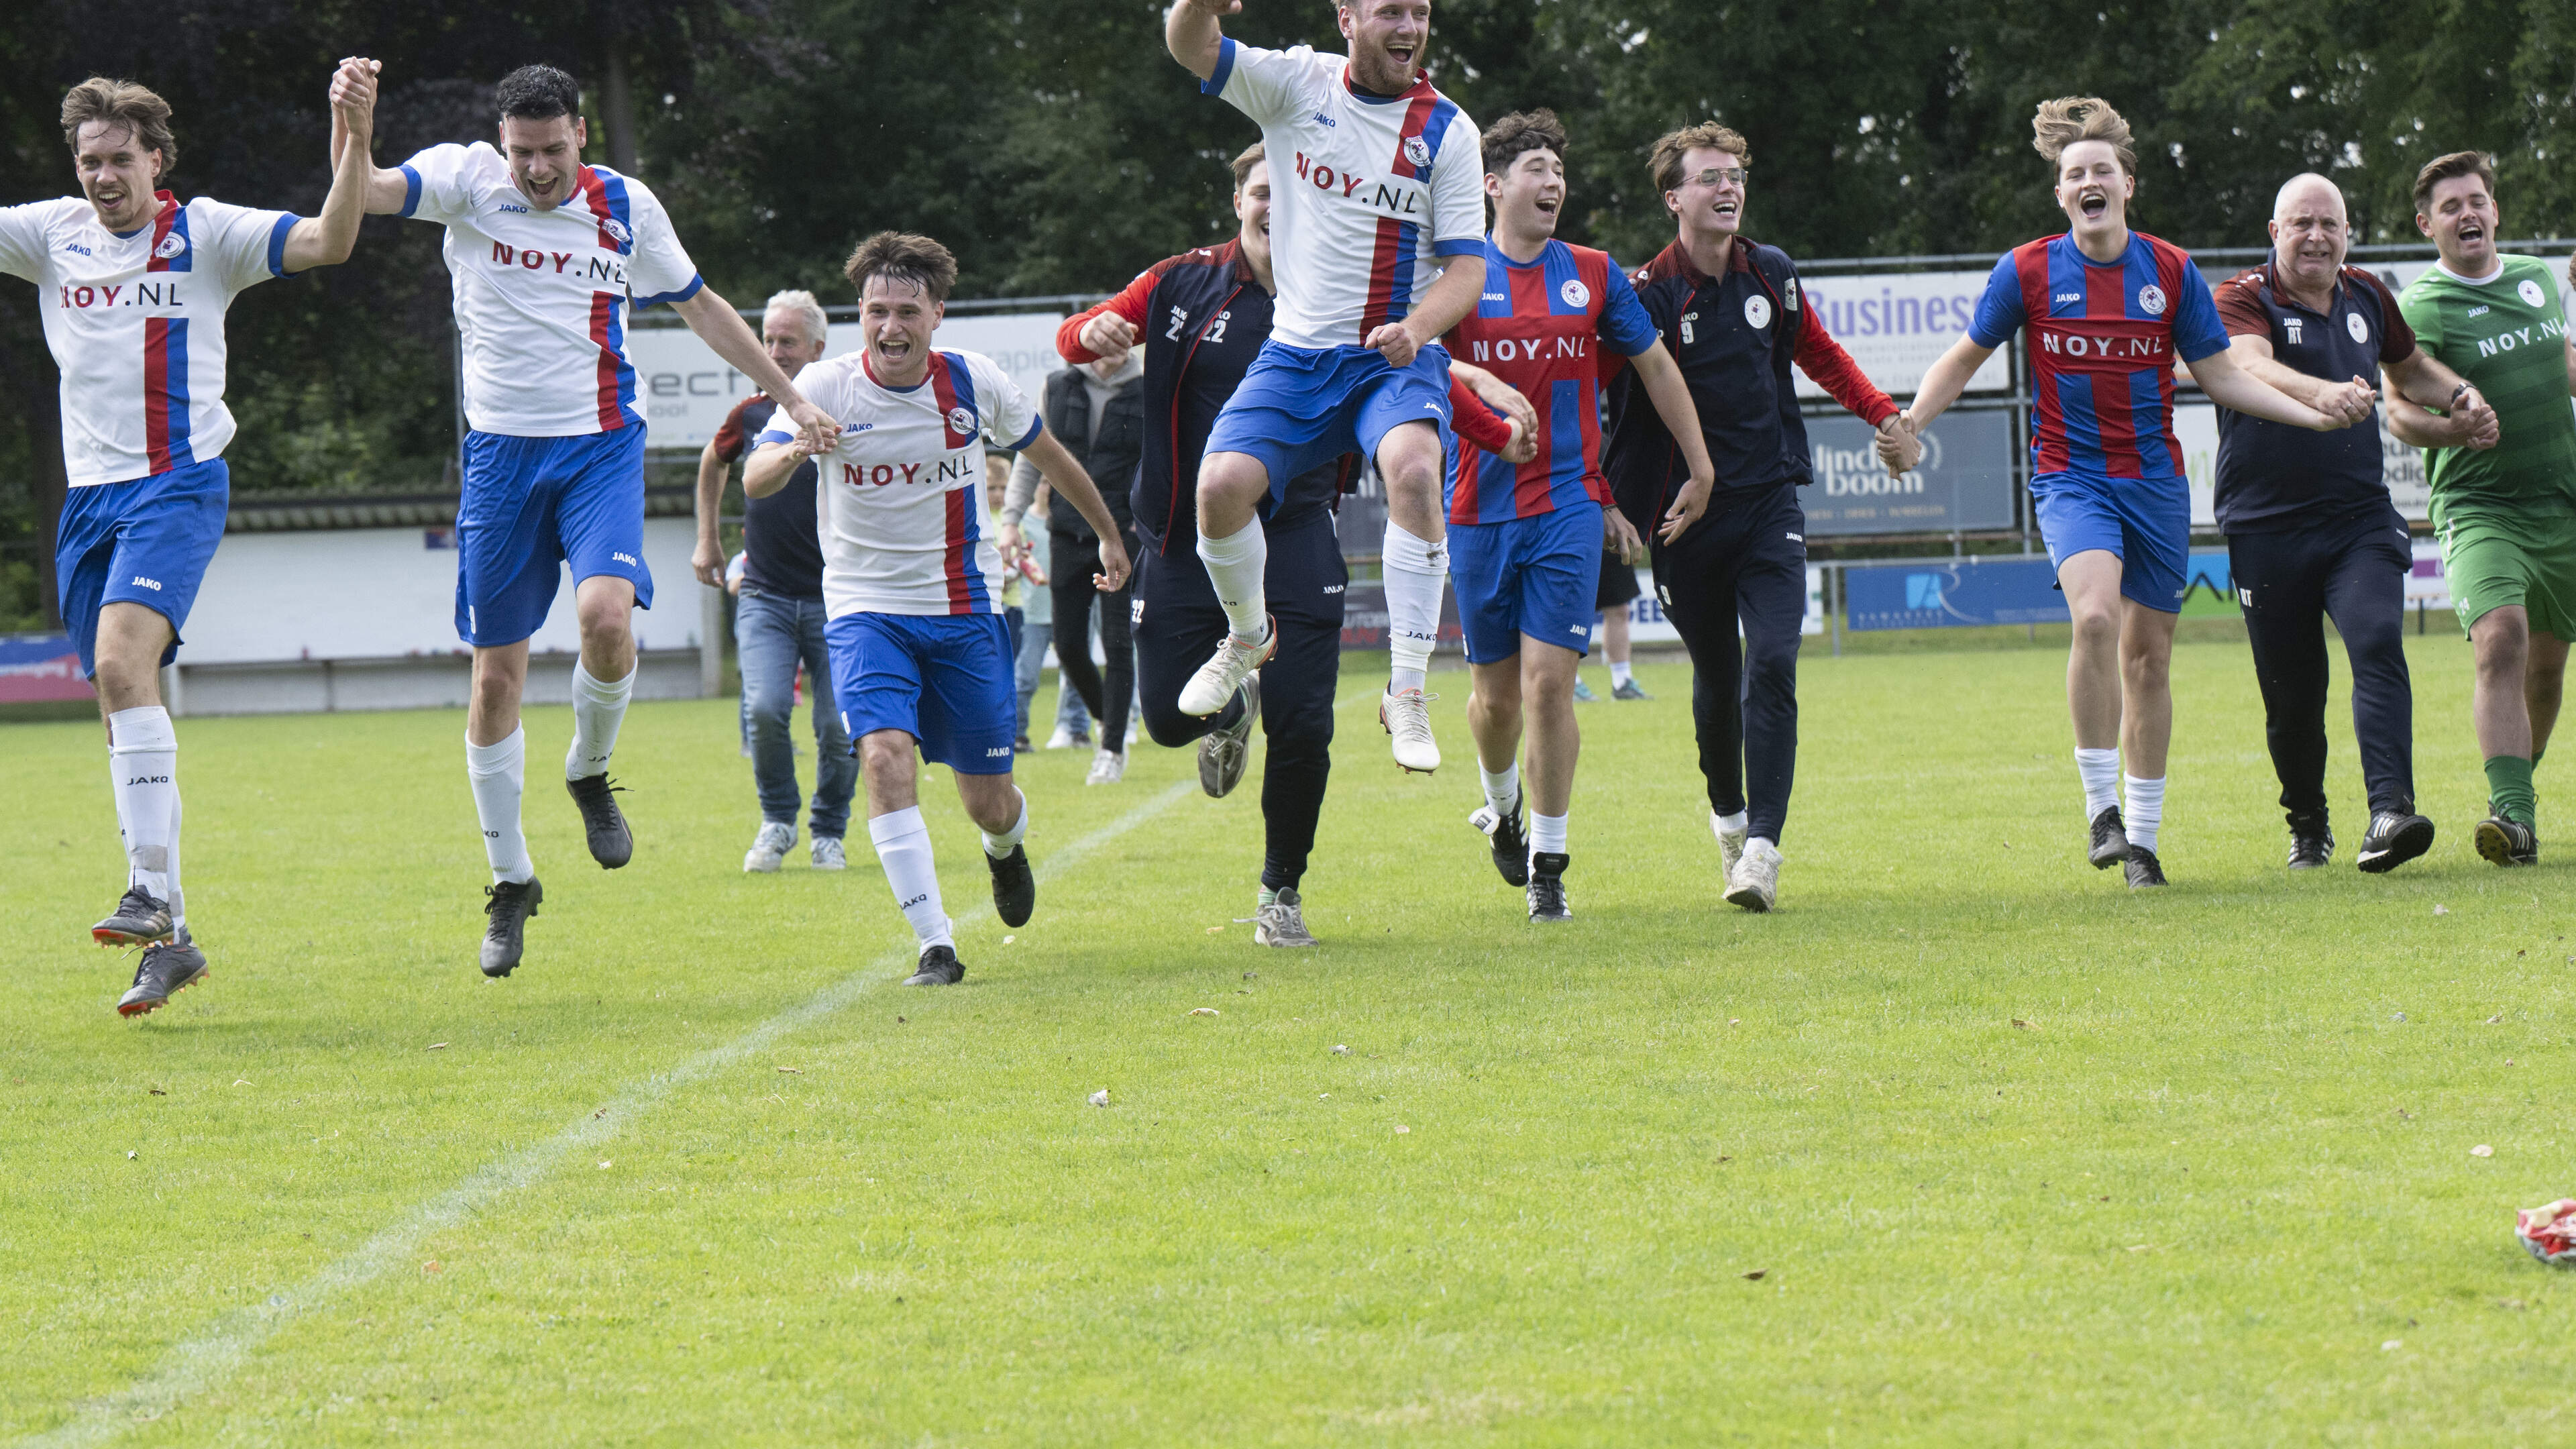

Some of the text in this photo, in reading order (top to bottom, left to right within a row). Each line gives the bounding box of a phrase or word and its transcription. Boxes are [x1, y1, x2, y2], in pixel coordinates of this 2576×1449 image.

[1313, 112, 1336, 127] JAKO
[1296, 151, 1417, 213] NOY.NL
[499, 204, 528, 213] JAKO
[66, 244, 91, 256] JAKO
[492, 240, 626, 284] NOY.NL
[1481, 292, 1505, 301] JAKO
[2055, 293, 2080, 302] JAKO
[1805, 287, 1982, 337] Busines
[2467, 305, 2489, 318] JAKO
[2284, 317, 2302, 327] JAKO
[1681, 321, 1694, 344] 9
[2288, 327, 2302, 343] RT
[2477, 317, 2566, 358] NOY.NL
[1472, 336, 1585, 362] NOY.NL
[2043, 332, 2162, 356] NOY.NL
[847, 423, 873, 432] JAKO
[843, 455, 973, 486] NOY.NL
[1825, 470, 1924, 496] boom
[1786, 532, 1803, 542] JAKO
[612, 551, 637, 567] JAKO
[131, 576, 161, 591] JAKO
[986, 747, 1010, 757] JAKO
[127, 775, 168, 786] JAKO
